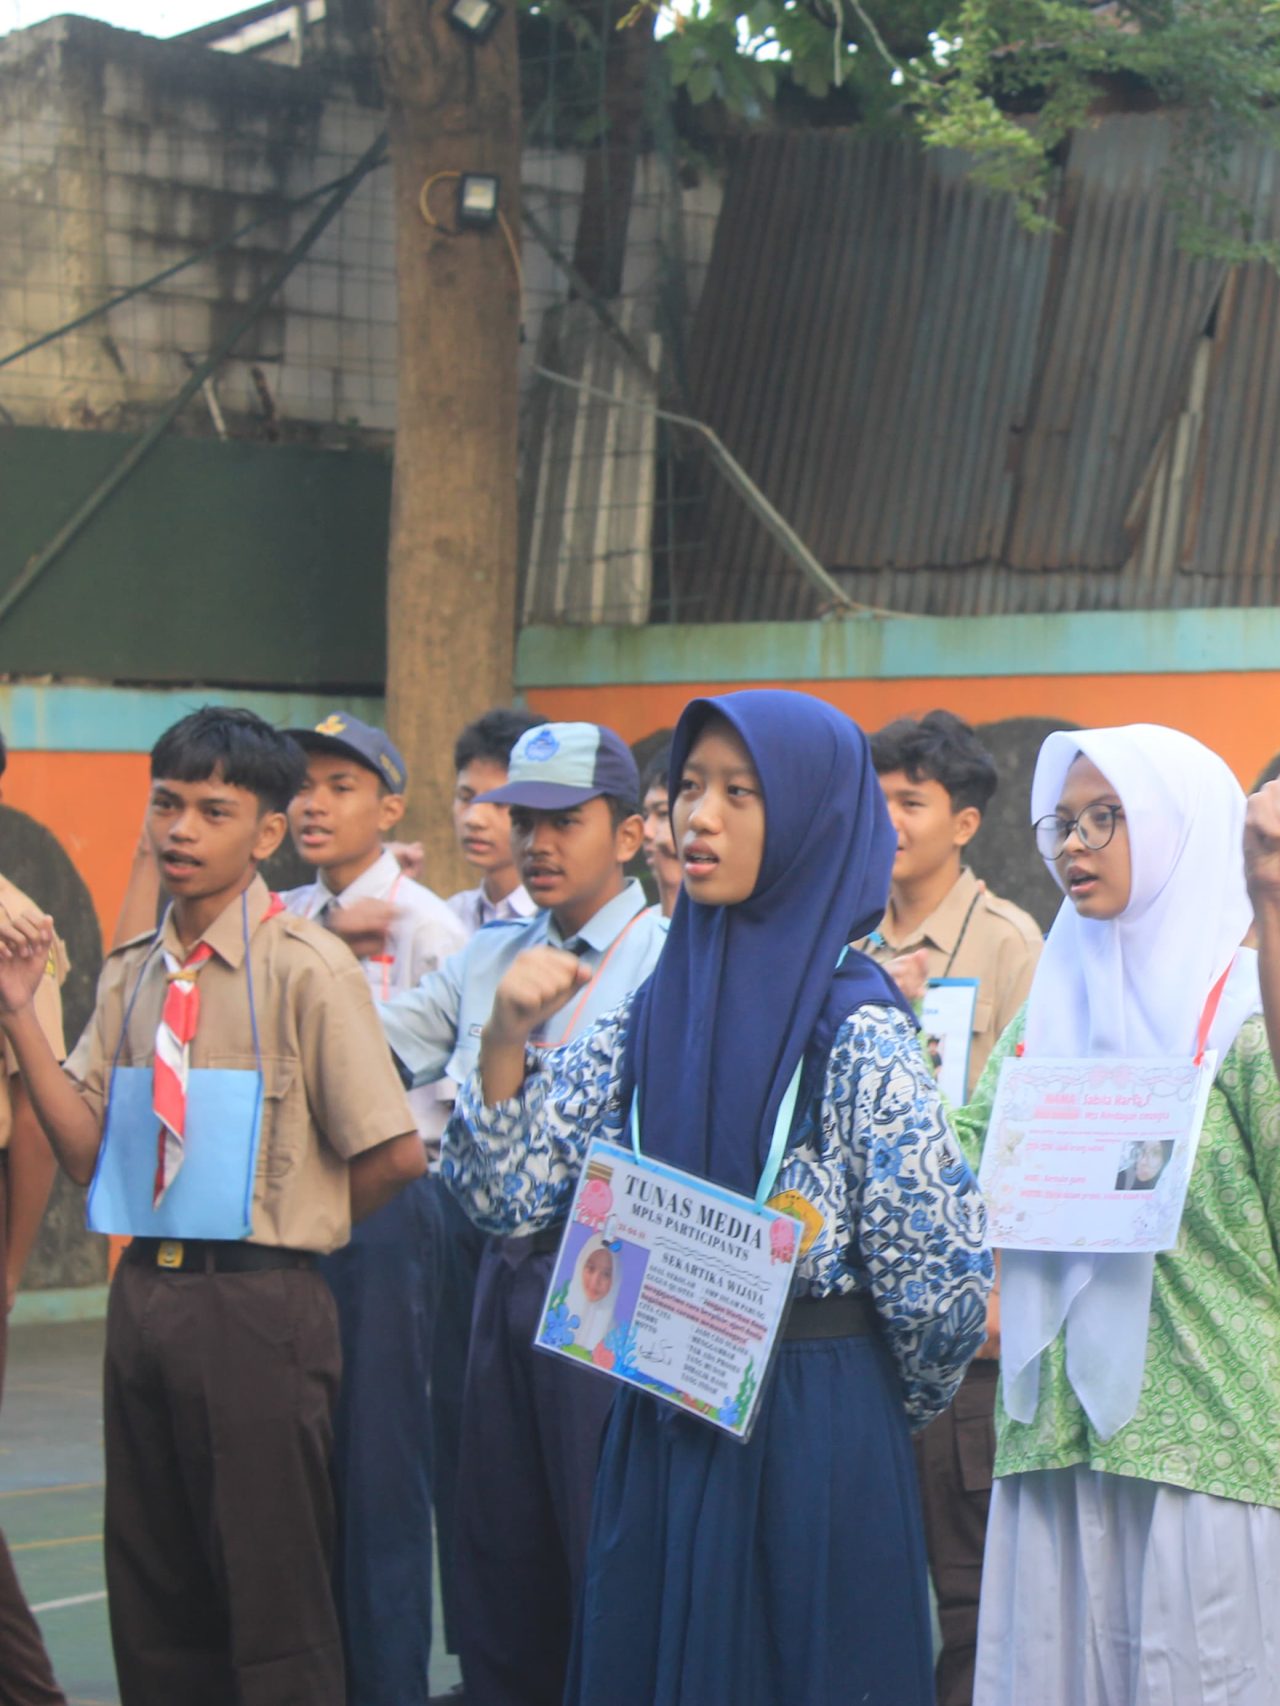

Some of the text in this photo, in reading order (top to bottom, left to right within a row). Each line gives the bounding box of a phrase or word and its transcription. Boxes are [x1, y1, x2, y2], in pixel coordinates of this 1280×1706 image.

[625, 1174, 763, 1249] TUNAS MEDIA
[631, 1203, 749, 1262] MPLS PARTICIPANTS
[662, 1252, 764, 1306] SEKARTIKA WIJAYA
